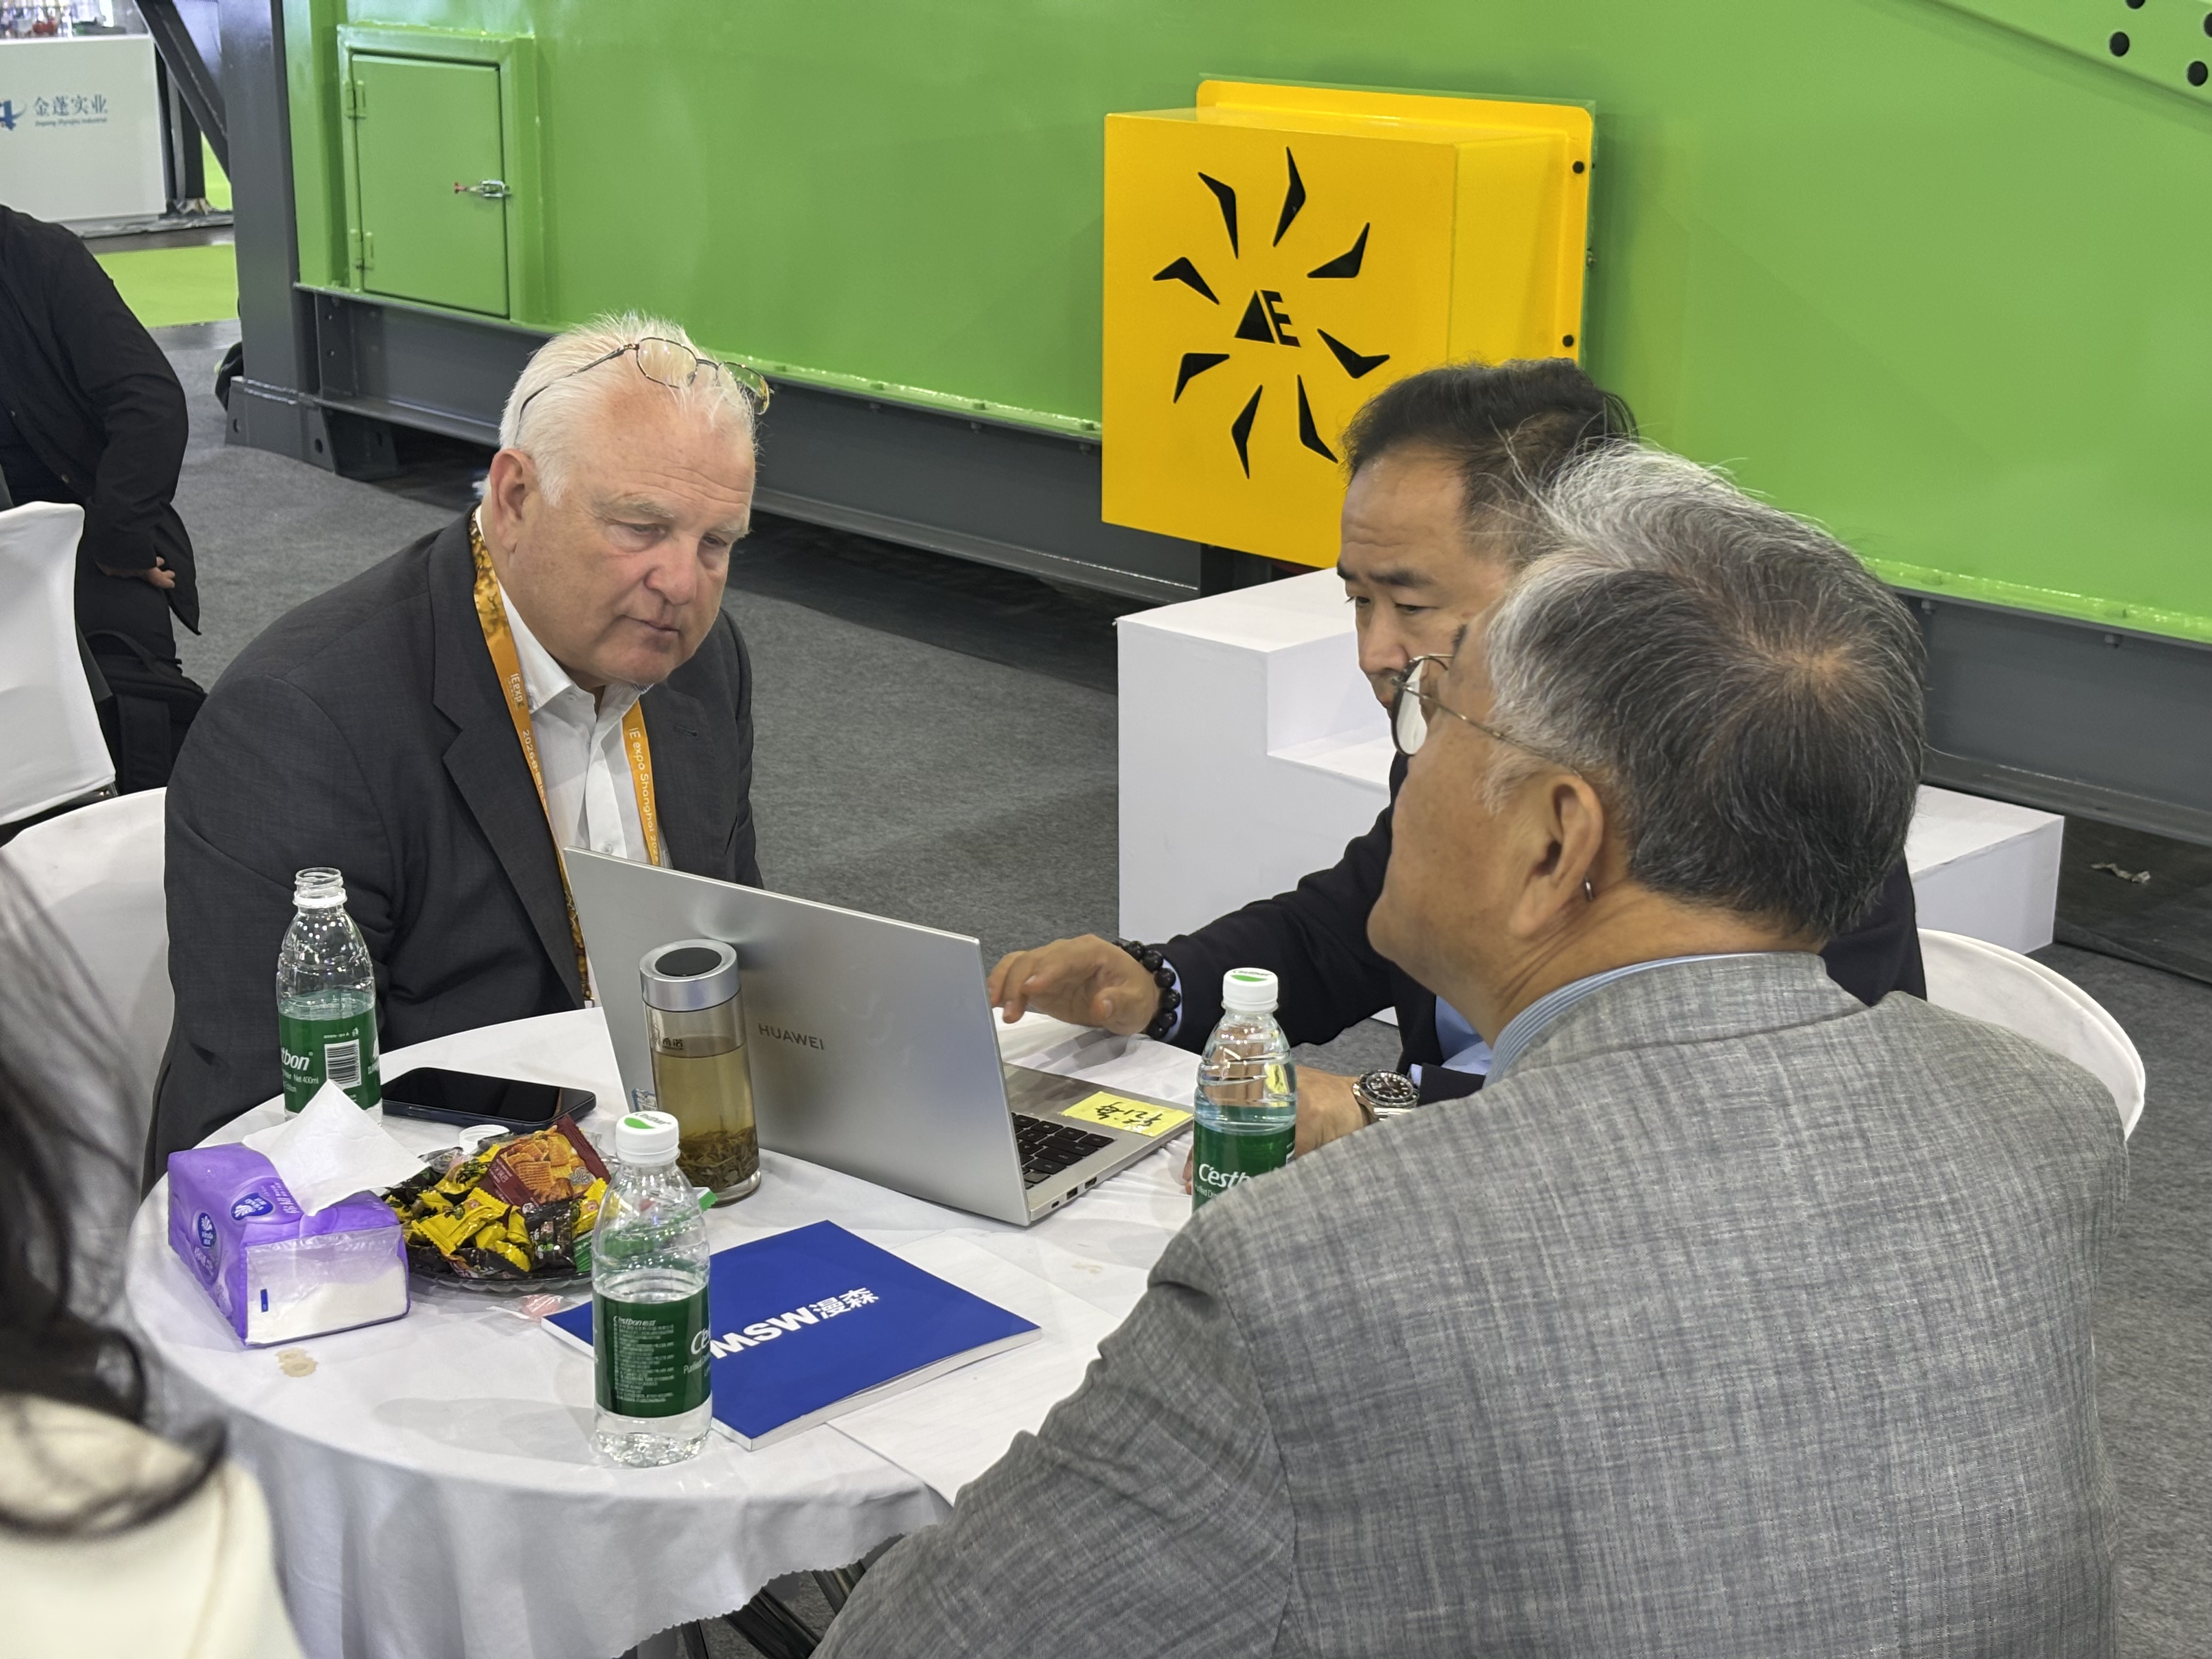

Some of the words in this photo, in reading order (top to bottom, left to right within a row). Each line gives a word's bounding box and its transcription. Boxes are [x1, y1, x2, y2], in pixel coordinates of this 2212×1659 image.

[629, 727, 641, 740] IE
[633, 742, 645, 770] expo
[640, 774, 654, 832] Shanghai
[758, 1023, 825, 1050] HUAWEI
